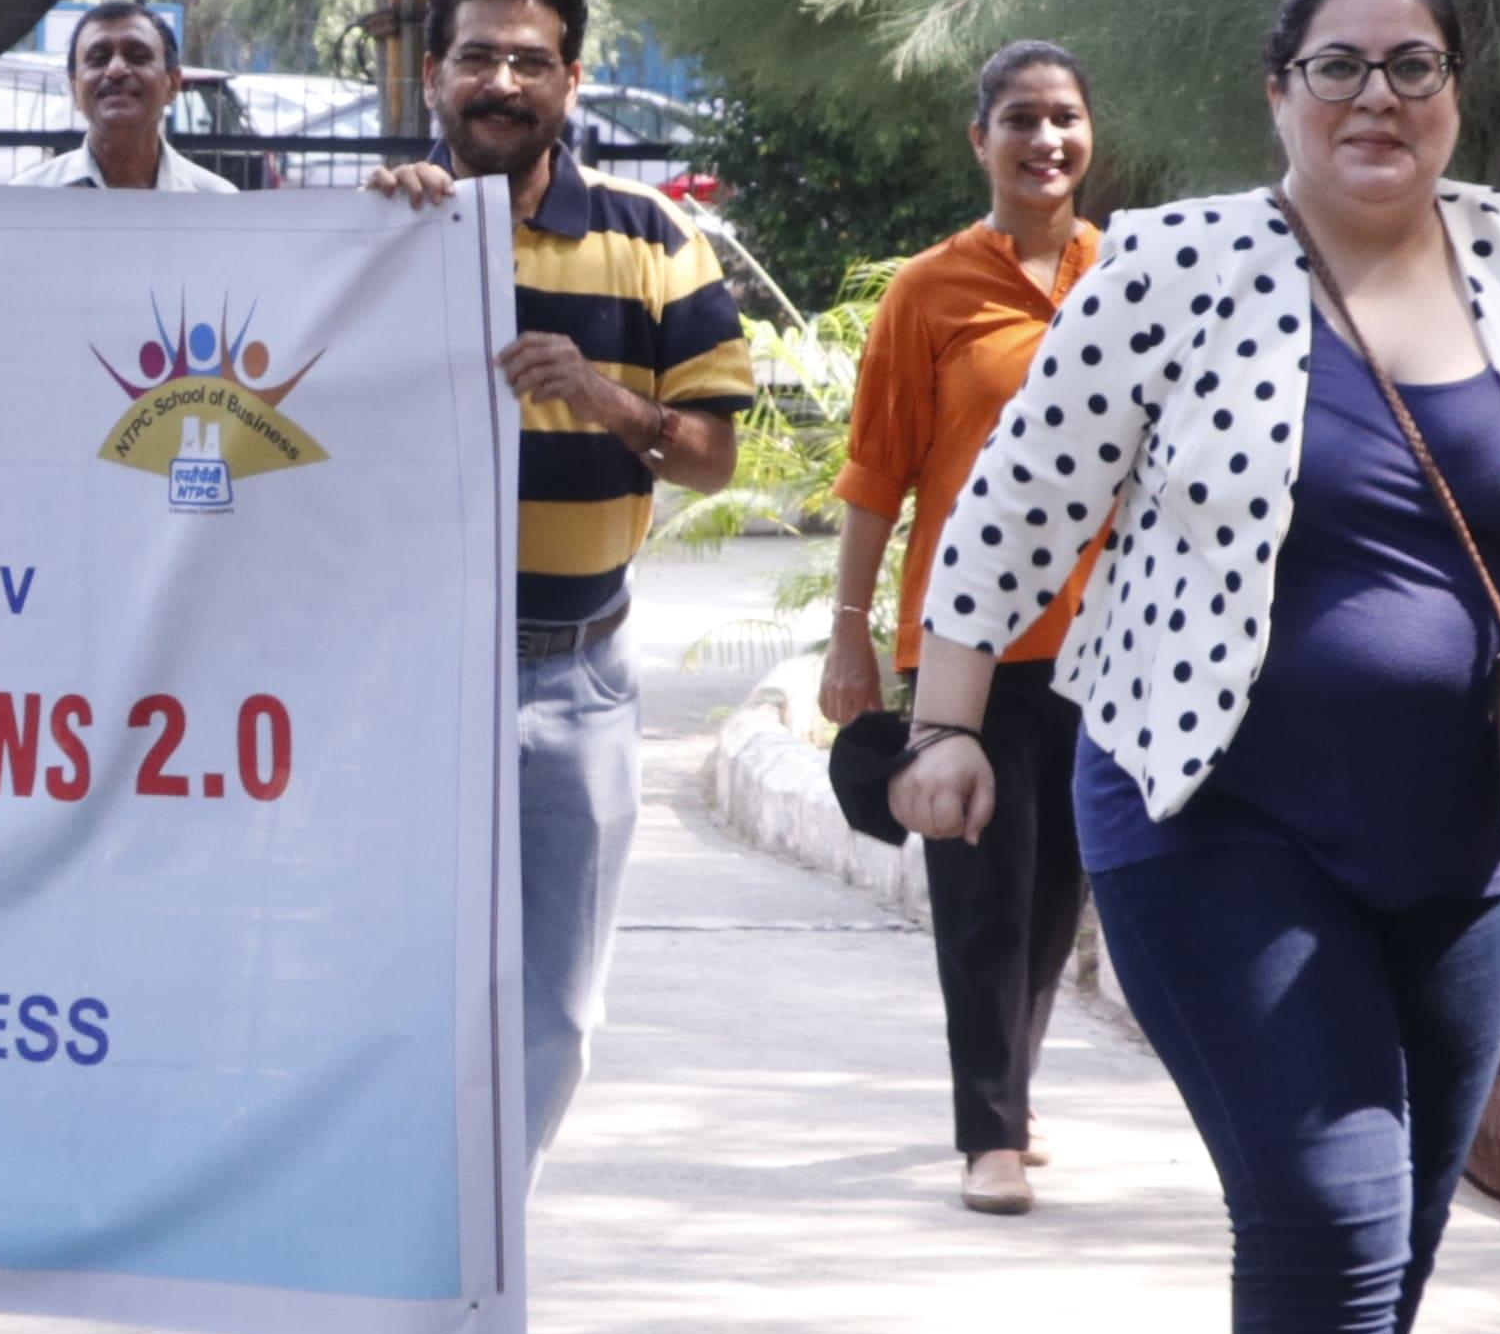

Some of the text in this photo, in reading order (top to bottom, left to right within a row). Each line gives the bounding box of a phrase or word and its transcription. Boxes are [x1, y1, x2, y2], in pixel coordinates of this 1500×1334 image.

[113, 386, 301, 461] NTPC School of Business
[177, 485, 219, 500] NTPC
[127, 693, 292, 802] 2.0
